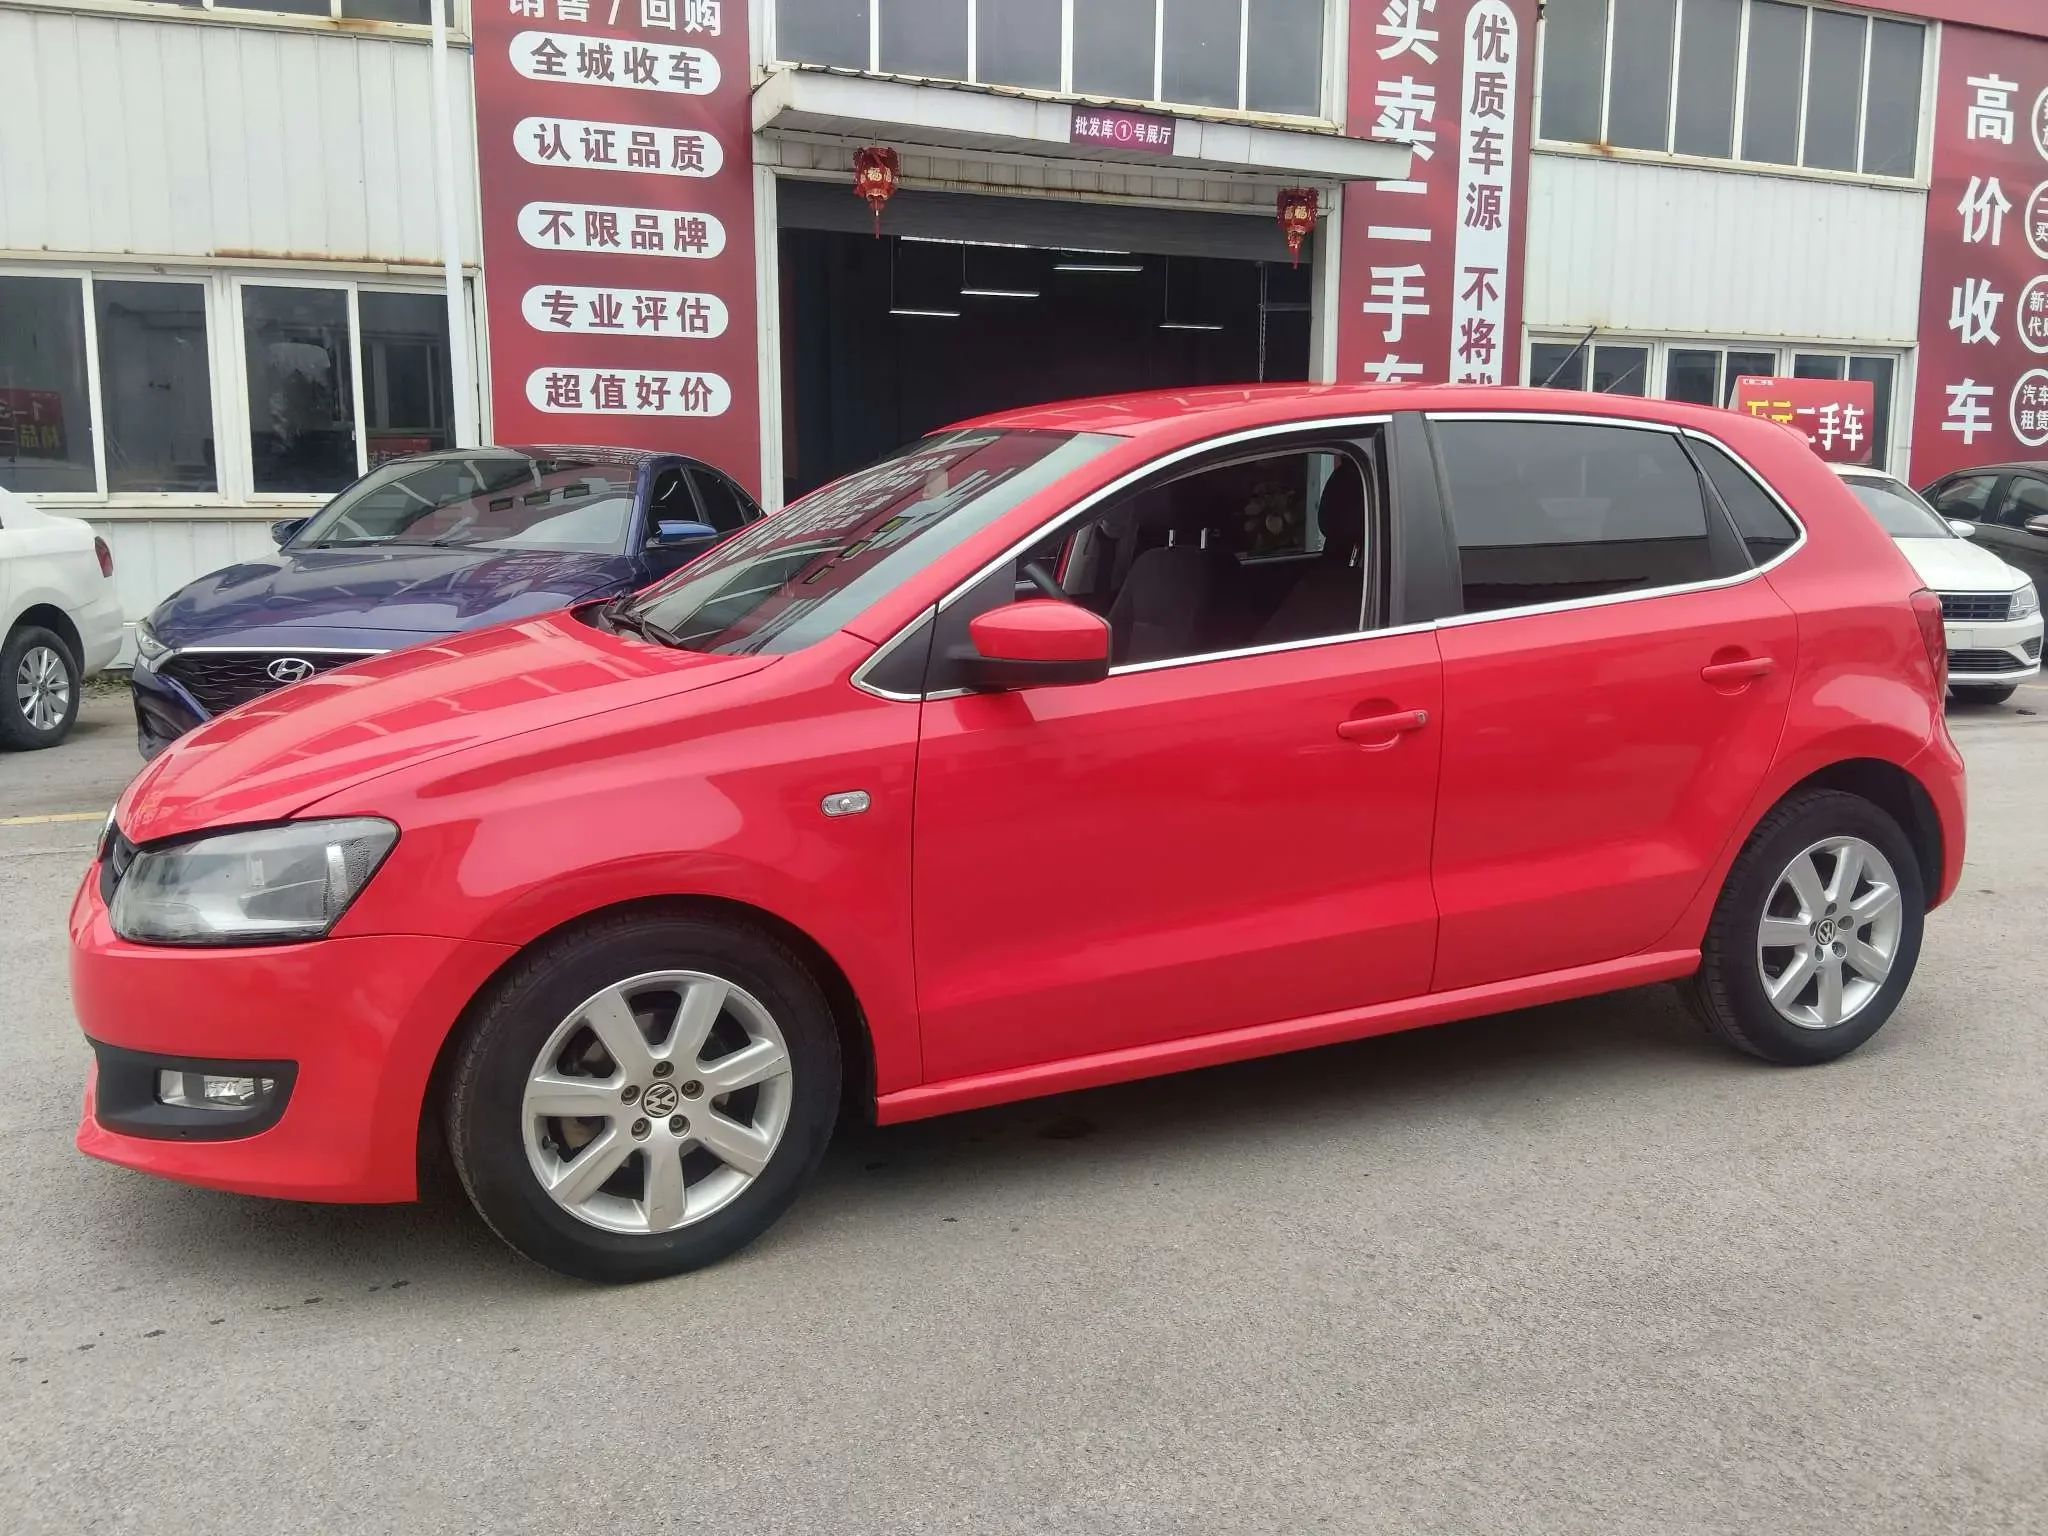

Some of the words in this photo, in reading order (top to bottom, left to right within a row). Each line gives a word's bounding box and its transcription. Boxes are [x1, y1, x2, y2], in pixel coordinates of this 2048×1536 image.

[530, 37, 703, 90] 全城收车
[1463, 13, 1510, 231] 优质车源
[533, 123, 705, 173] 认证品质
[538, 208, 710, 254] 不限品牌
[1942, 73, 2019, 445] 高价收车
[541, 289, 712, 334] 专业评估
[1457, 266, 1499, 384] 不将
[2029, 291, 2048, 312] 新
[545, 372, 714, 413] 超值好价
